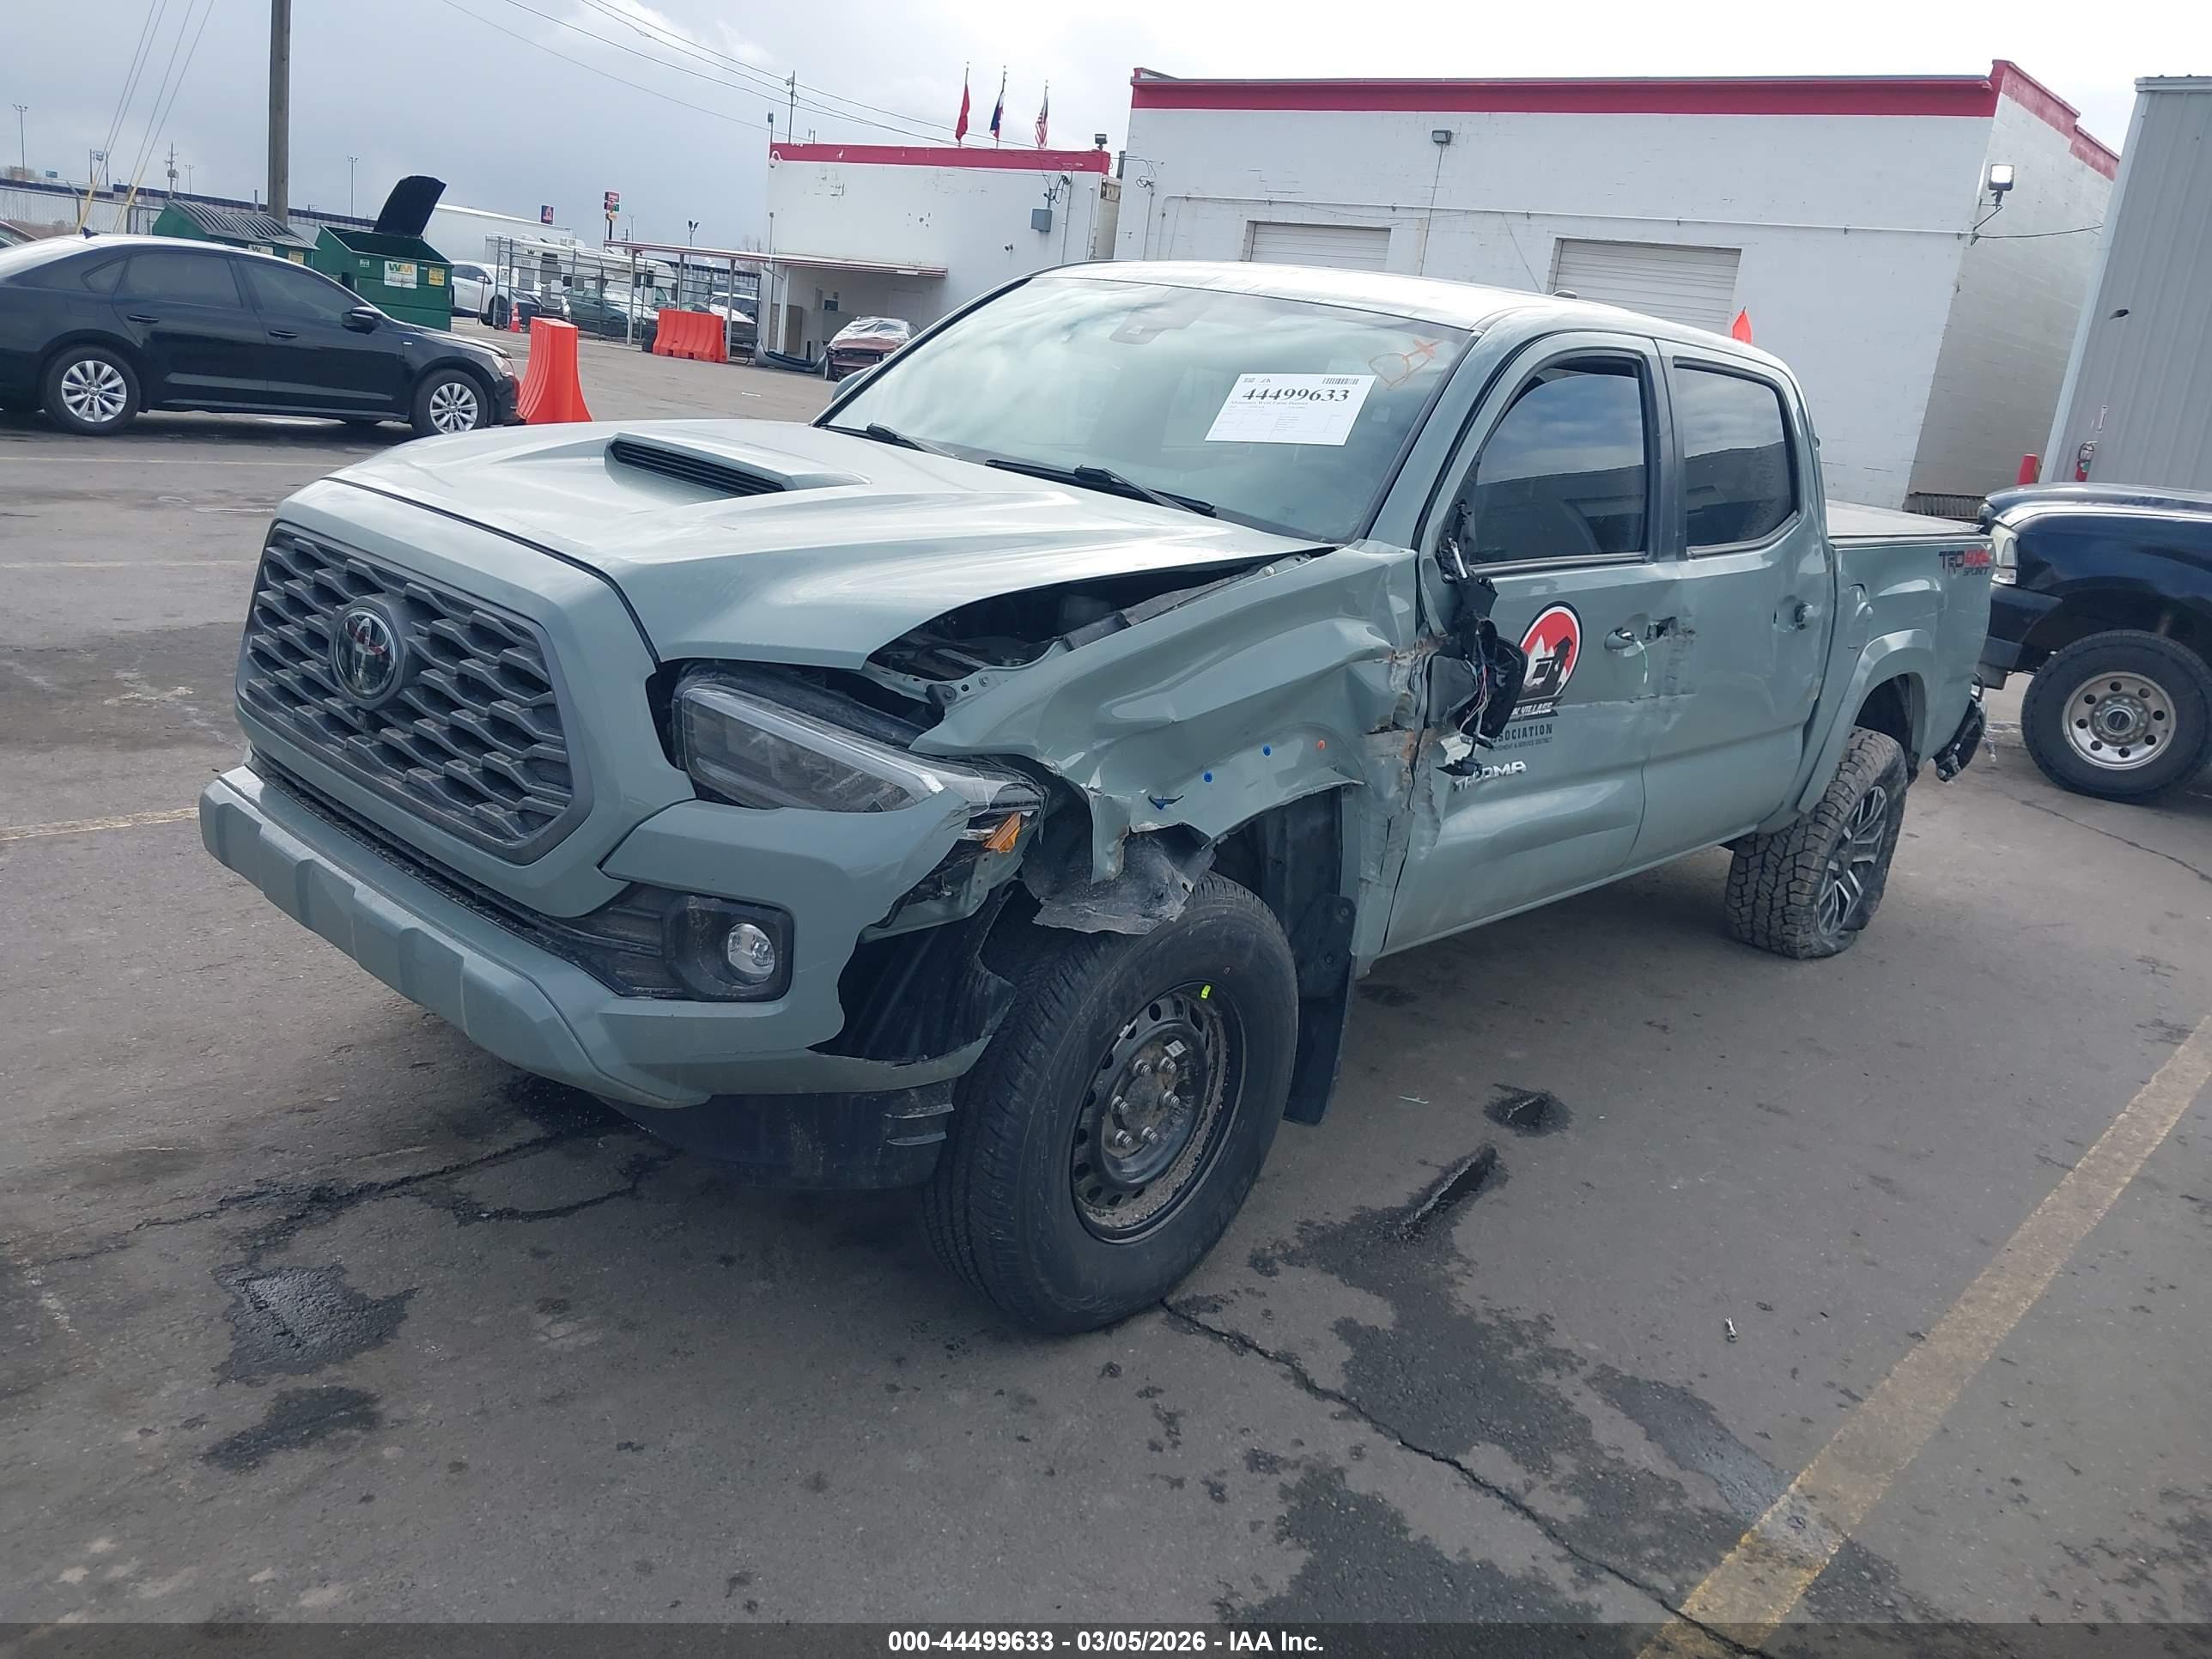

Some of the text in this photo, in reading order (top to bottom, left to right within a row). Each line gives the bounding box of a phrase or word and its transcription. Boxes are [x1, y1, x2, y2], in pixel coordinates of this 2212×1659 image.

[389, 263, 412, 273] WM
[1242, 388, 1350, 401] 44499633
[1938, 550, 1965, 574] TRD
[1964, 567, 1989, 576] SPORT
[1491, 724, 1553, 743] SOCIATION
